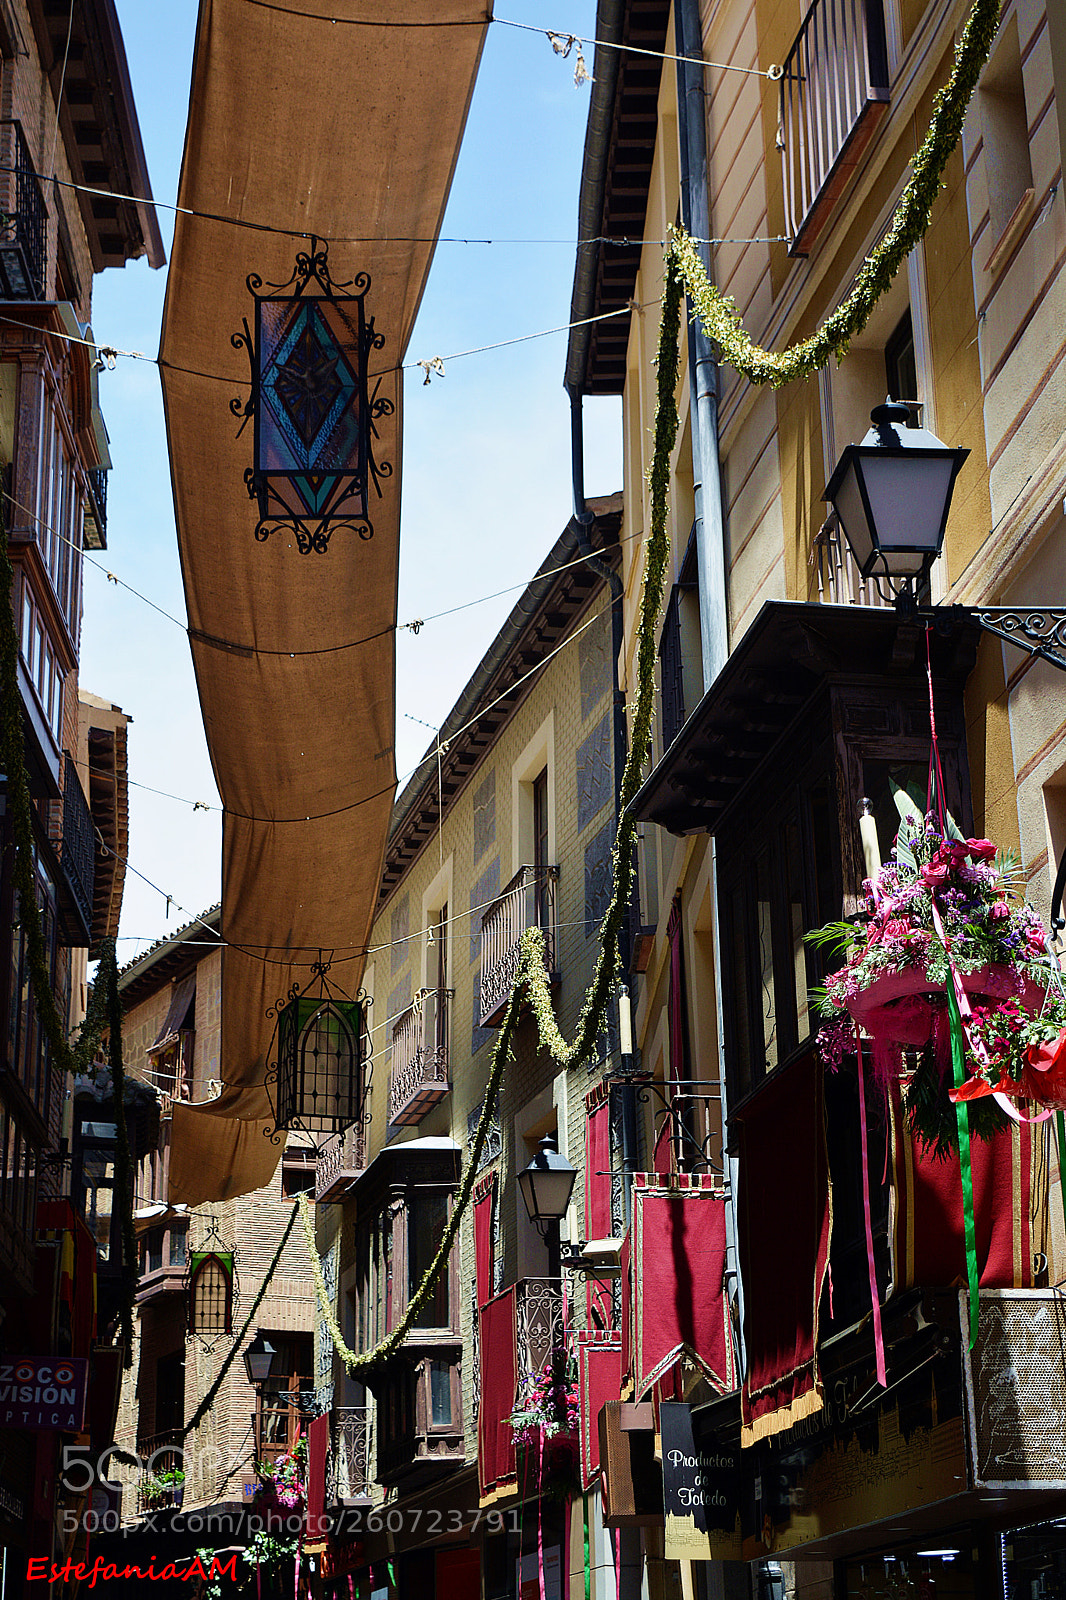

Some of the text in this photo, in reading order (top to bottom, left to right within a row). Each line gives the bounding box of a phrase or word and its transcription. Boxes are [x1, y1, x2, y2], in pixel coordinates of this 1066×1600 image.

[0, 1364, 75, 1385] ZOCO
[0, 1384, 77, 1405] VISIÓN
[667, 1449, 734, 1468] Productos
[694, 1470, 709, 1486] de
[677, 1487, 727, 1506] Toledo
